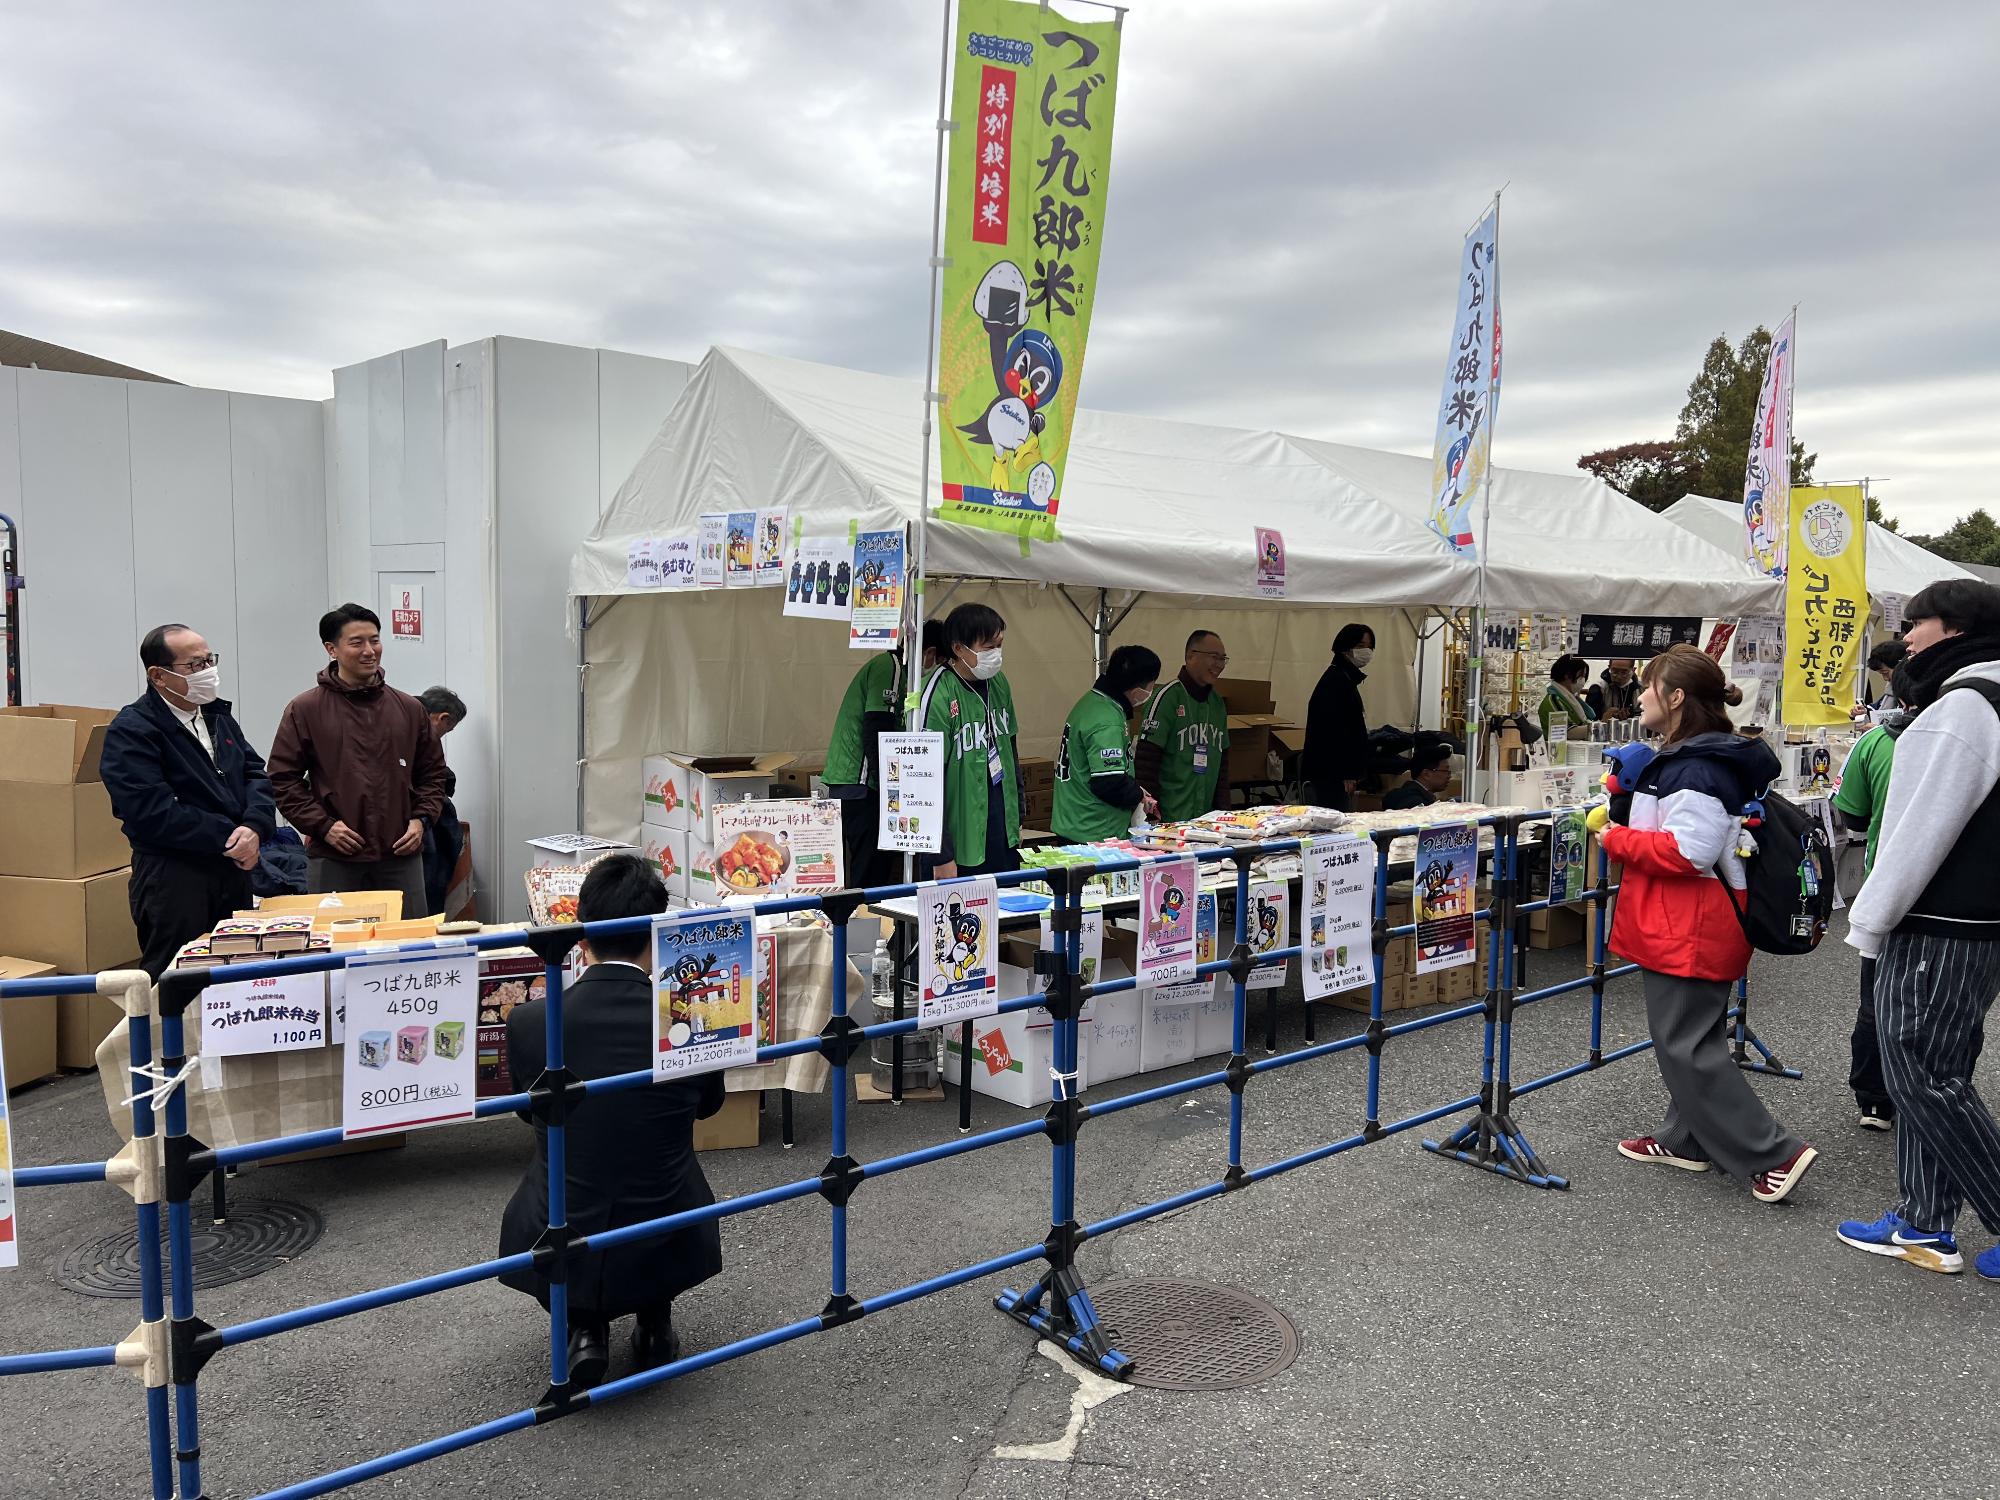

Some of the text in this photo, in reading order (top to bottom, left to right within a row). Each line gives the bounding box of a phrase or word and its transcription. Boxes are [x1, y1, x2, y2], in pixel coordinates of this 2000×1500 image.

[970, 33, 1033, 53] えちごつばめの
[979, 48, 1022, 64] コシヒカリ
[979, 83, 1010, 229] 特別栽培米
[1030, 31, 1106, 324] つば九郎米
[1612, 623, 1646, 647] 新潟県
[720, 813, 812, 829] トマ味噌カレー豚丼
[1423, 830, 1474, 853] つば九郎米
[1561, 831, 1577, 842] 2025
[1322, 852, 1360, 869] つば九郎米
[665, 922, 745, 949] つば九郎米
[252, 978, 277, 988] 大好評
[363, 969, 462, 993] つば九郎米
[1151, 965, 1178, 982] 700円
[206, 1001, 231, 1010] 2025
[386, 997, 439, 1015] 450g
[211, 1005, 321, 1030] つば九郎米弁当
